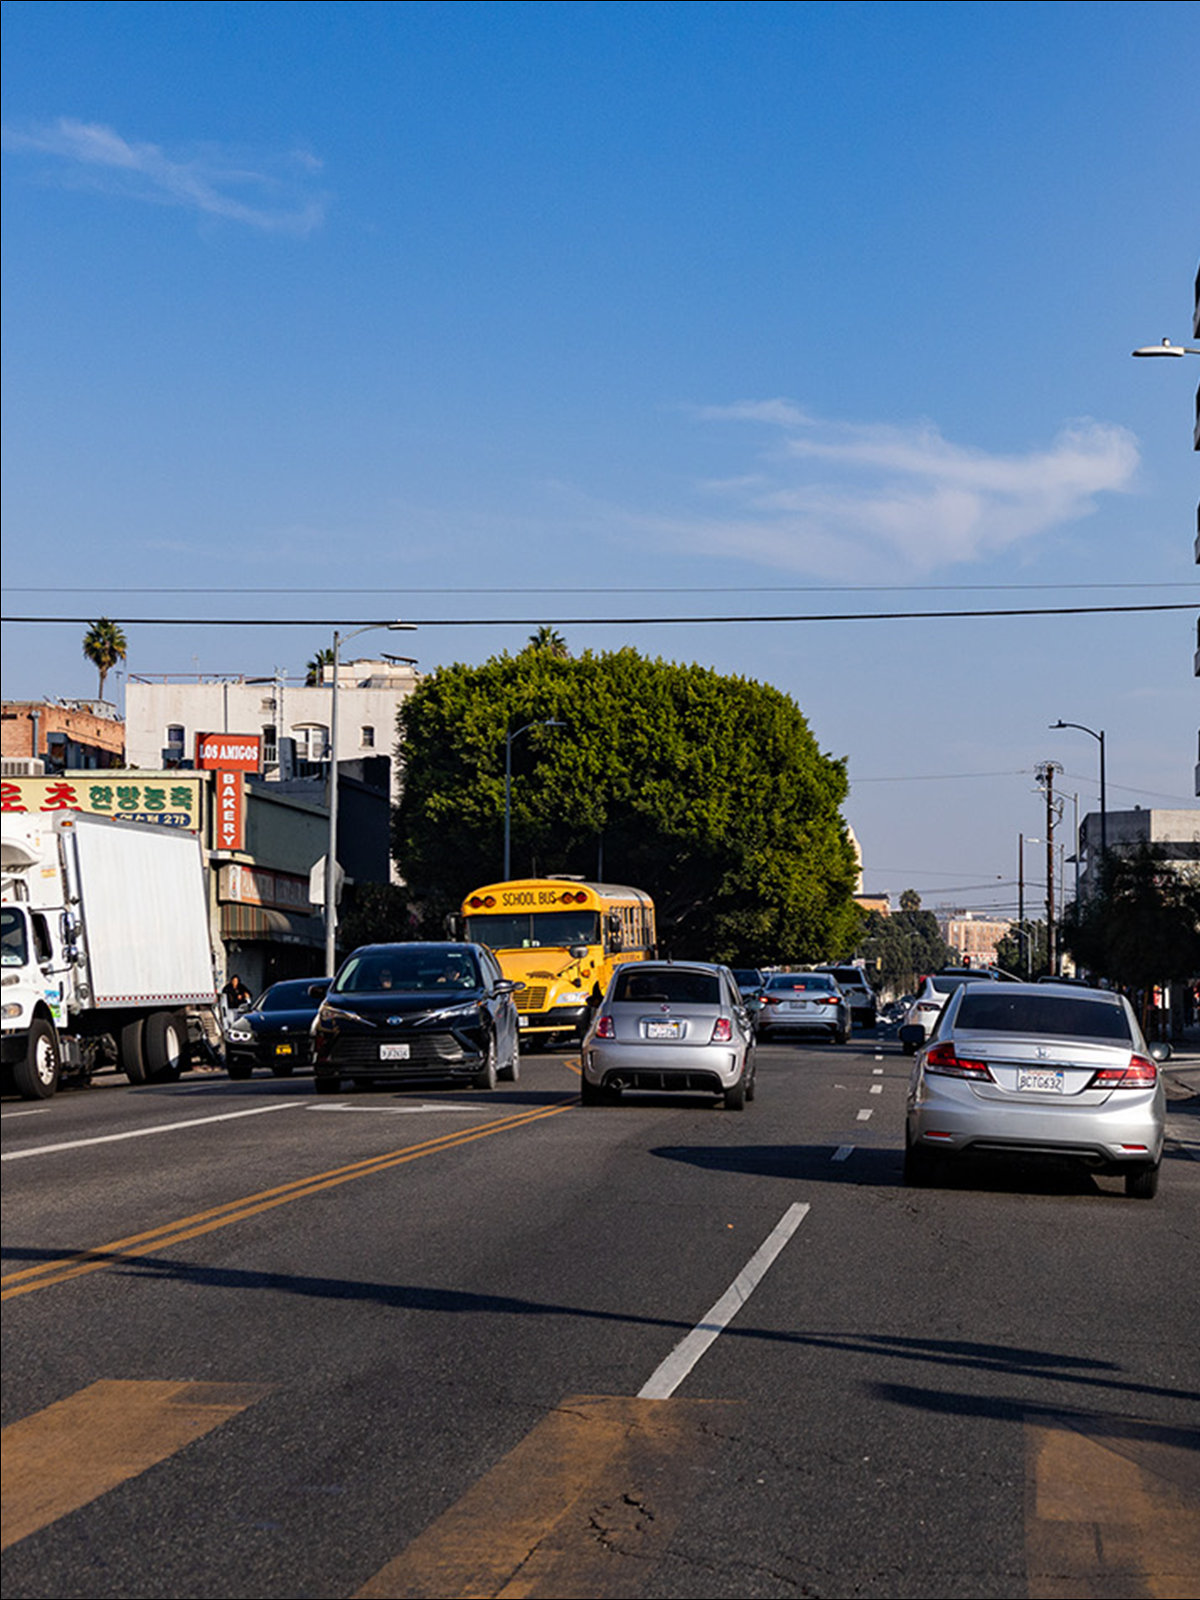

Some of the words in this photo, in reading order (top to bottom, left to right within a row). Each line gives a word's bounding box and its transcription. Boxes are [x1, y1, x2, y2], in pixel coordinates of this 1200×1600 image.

[199, 744, 218, 759] LOS
[219, 745, 259, 761] AMIGOS
[222, 773, 236, 846] BAKERY
[502, 891, 537, 907] SCHOOL
[538, 890, 557, 905] BUS
